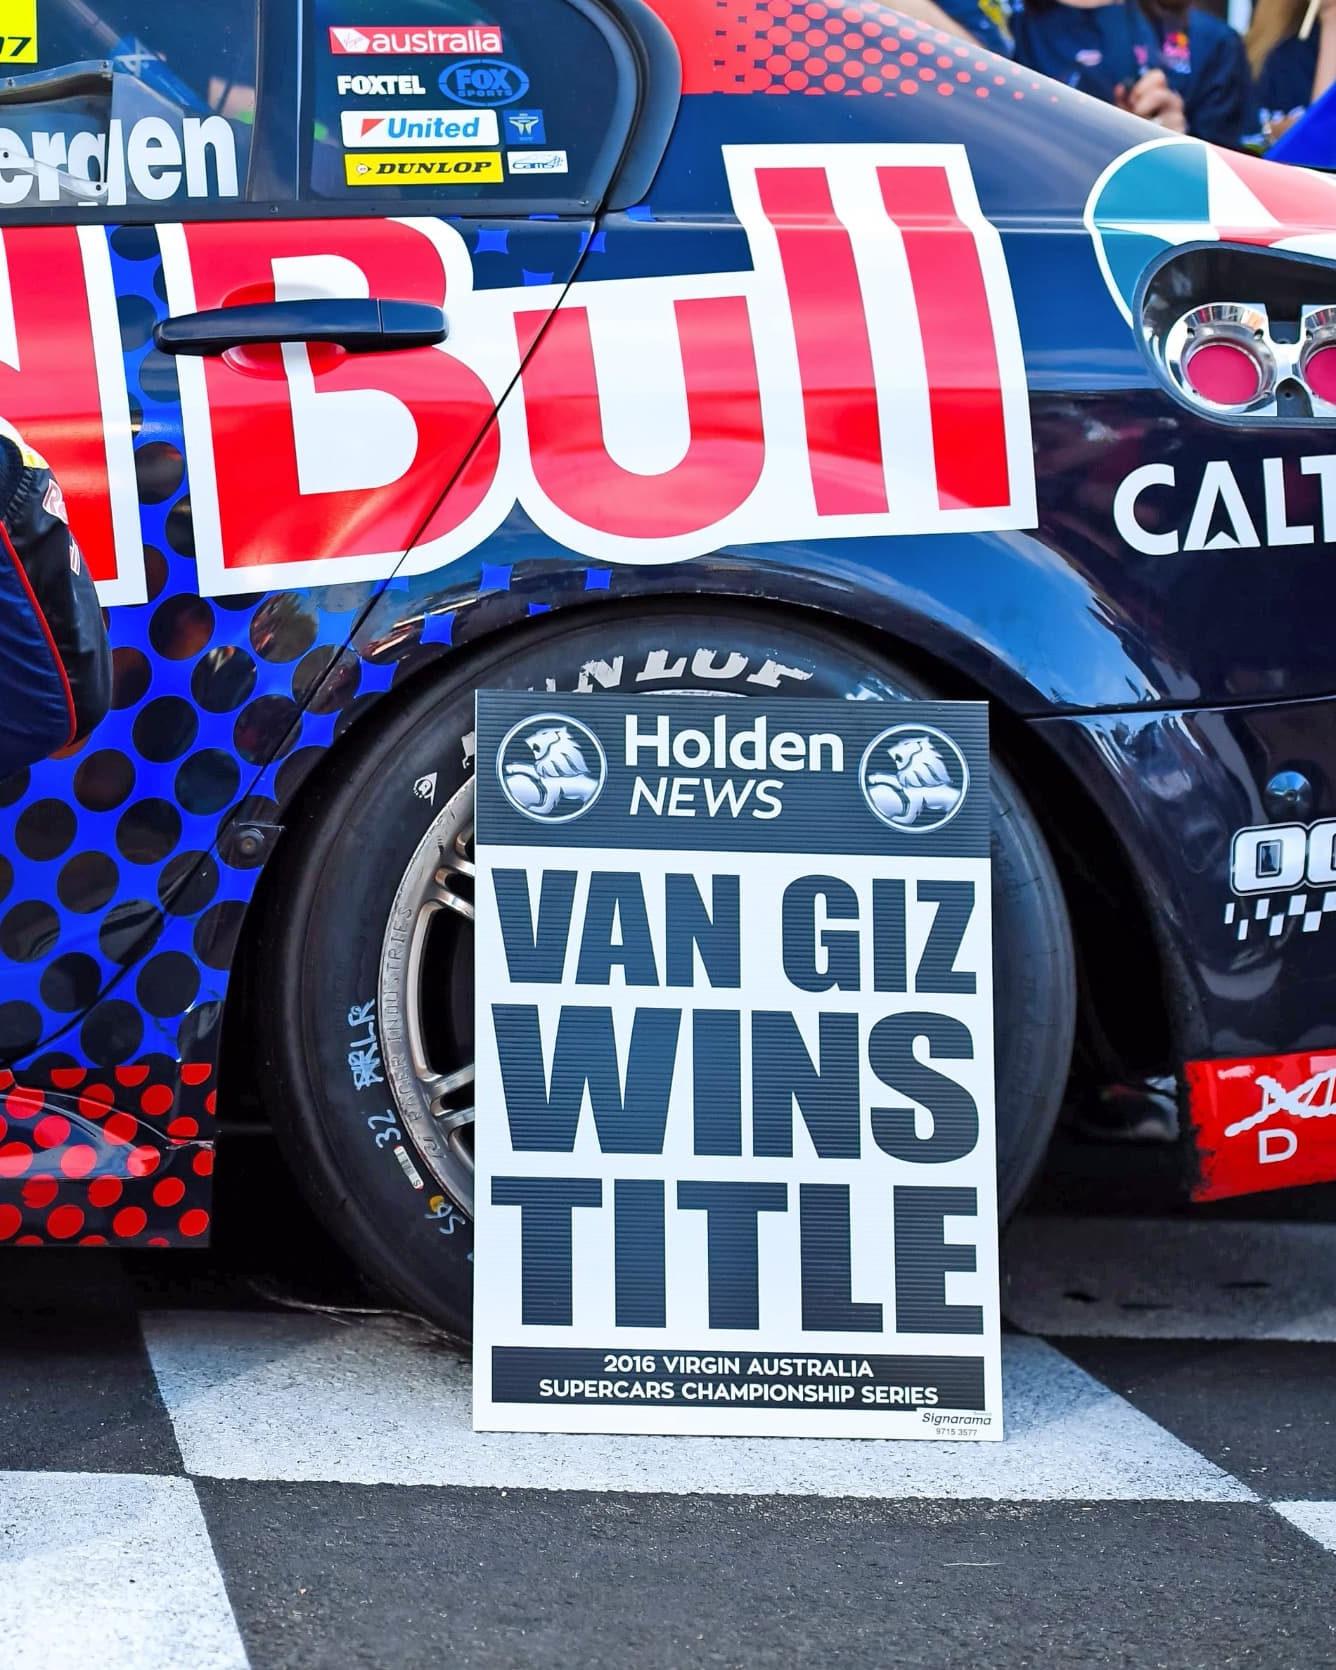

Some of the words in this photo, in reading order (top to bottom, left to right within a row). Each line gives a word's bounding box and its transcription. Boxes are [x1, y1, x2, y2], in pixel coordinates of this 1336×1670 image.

[372, 29, 501, 53] australia
[337, 74, 427, 96] FOXTEL
[455, 68, 512, 90] FOX
[457, 89, 514, 98] SPORTS
[387, 116, 480, 139] United
[375, 161, 493, 175] DUNLOP
[156, 142, 1038, 598] Bull
[625, 714, 845, 773] Holden
[629, 776, 785, 820] NEWS
[490, 866, 741, 990] VAN
[781, 873, 977, 995] GIZ
[490, 1002, 980, 1164] WINS
[490, 1175, 984, 1335] TITLE
[603, 1354, 656, 1374] 2016
[662, 1355, 741, 1376] VIRGIN
[747, 1357, 874, 1378] AUSTRALIA
[539, 1379, 675, 1400] SUPERCARS
[681, 1382, 855, 1403] CHAMPIONSHIP
[861, 1386, 939, 1405] SERIES
[921, 1412, 992, 1426] Signarama
